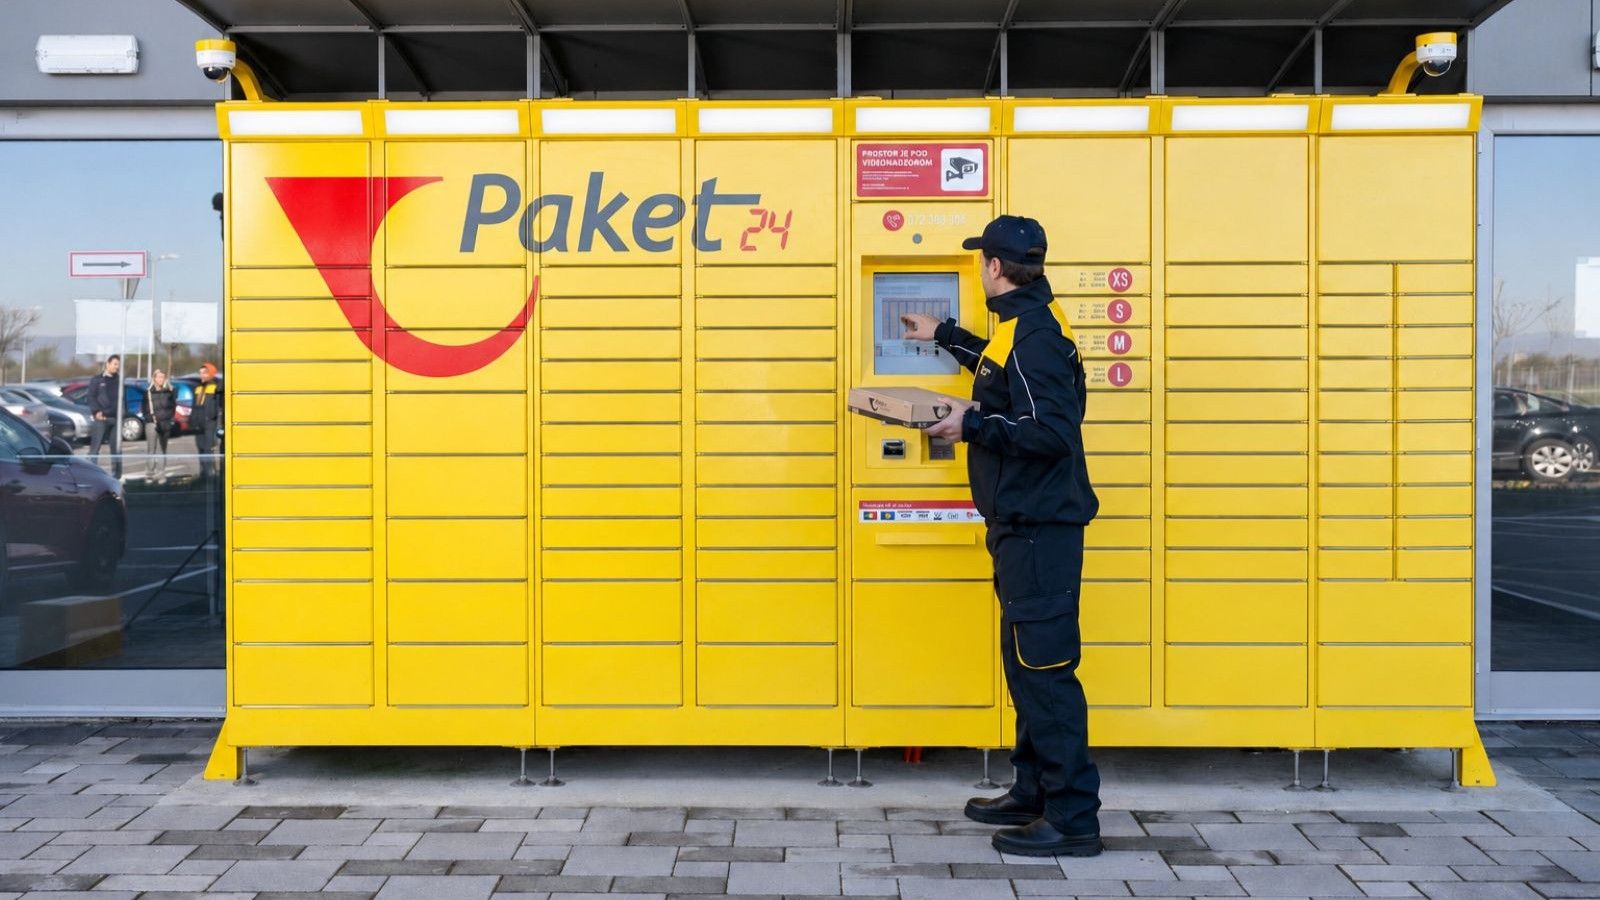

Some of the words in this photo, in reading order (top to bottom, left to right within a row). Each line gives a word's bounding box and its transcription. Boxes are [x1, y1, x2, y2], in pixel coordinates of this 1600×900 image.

[862, 150, 898, 158] PROSTOR
[900, 150, 909, 158] JE
[910, 150, 928, 158] POD
[862, 158, 933, 167] VIDEONADZOROM
[459, 171, 761, 253] Paket
[739, 208, 792, 252] 24
[1112, 272, 1129, 287] XS
[1116, 303, 1124, 319] S
[1114, 335, 1125, 351] M
[1116, 367, 1124, 382] L
